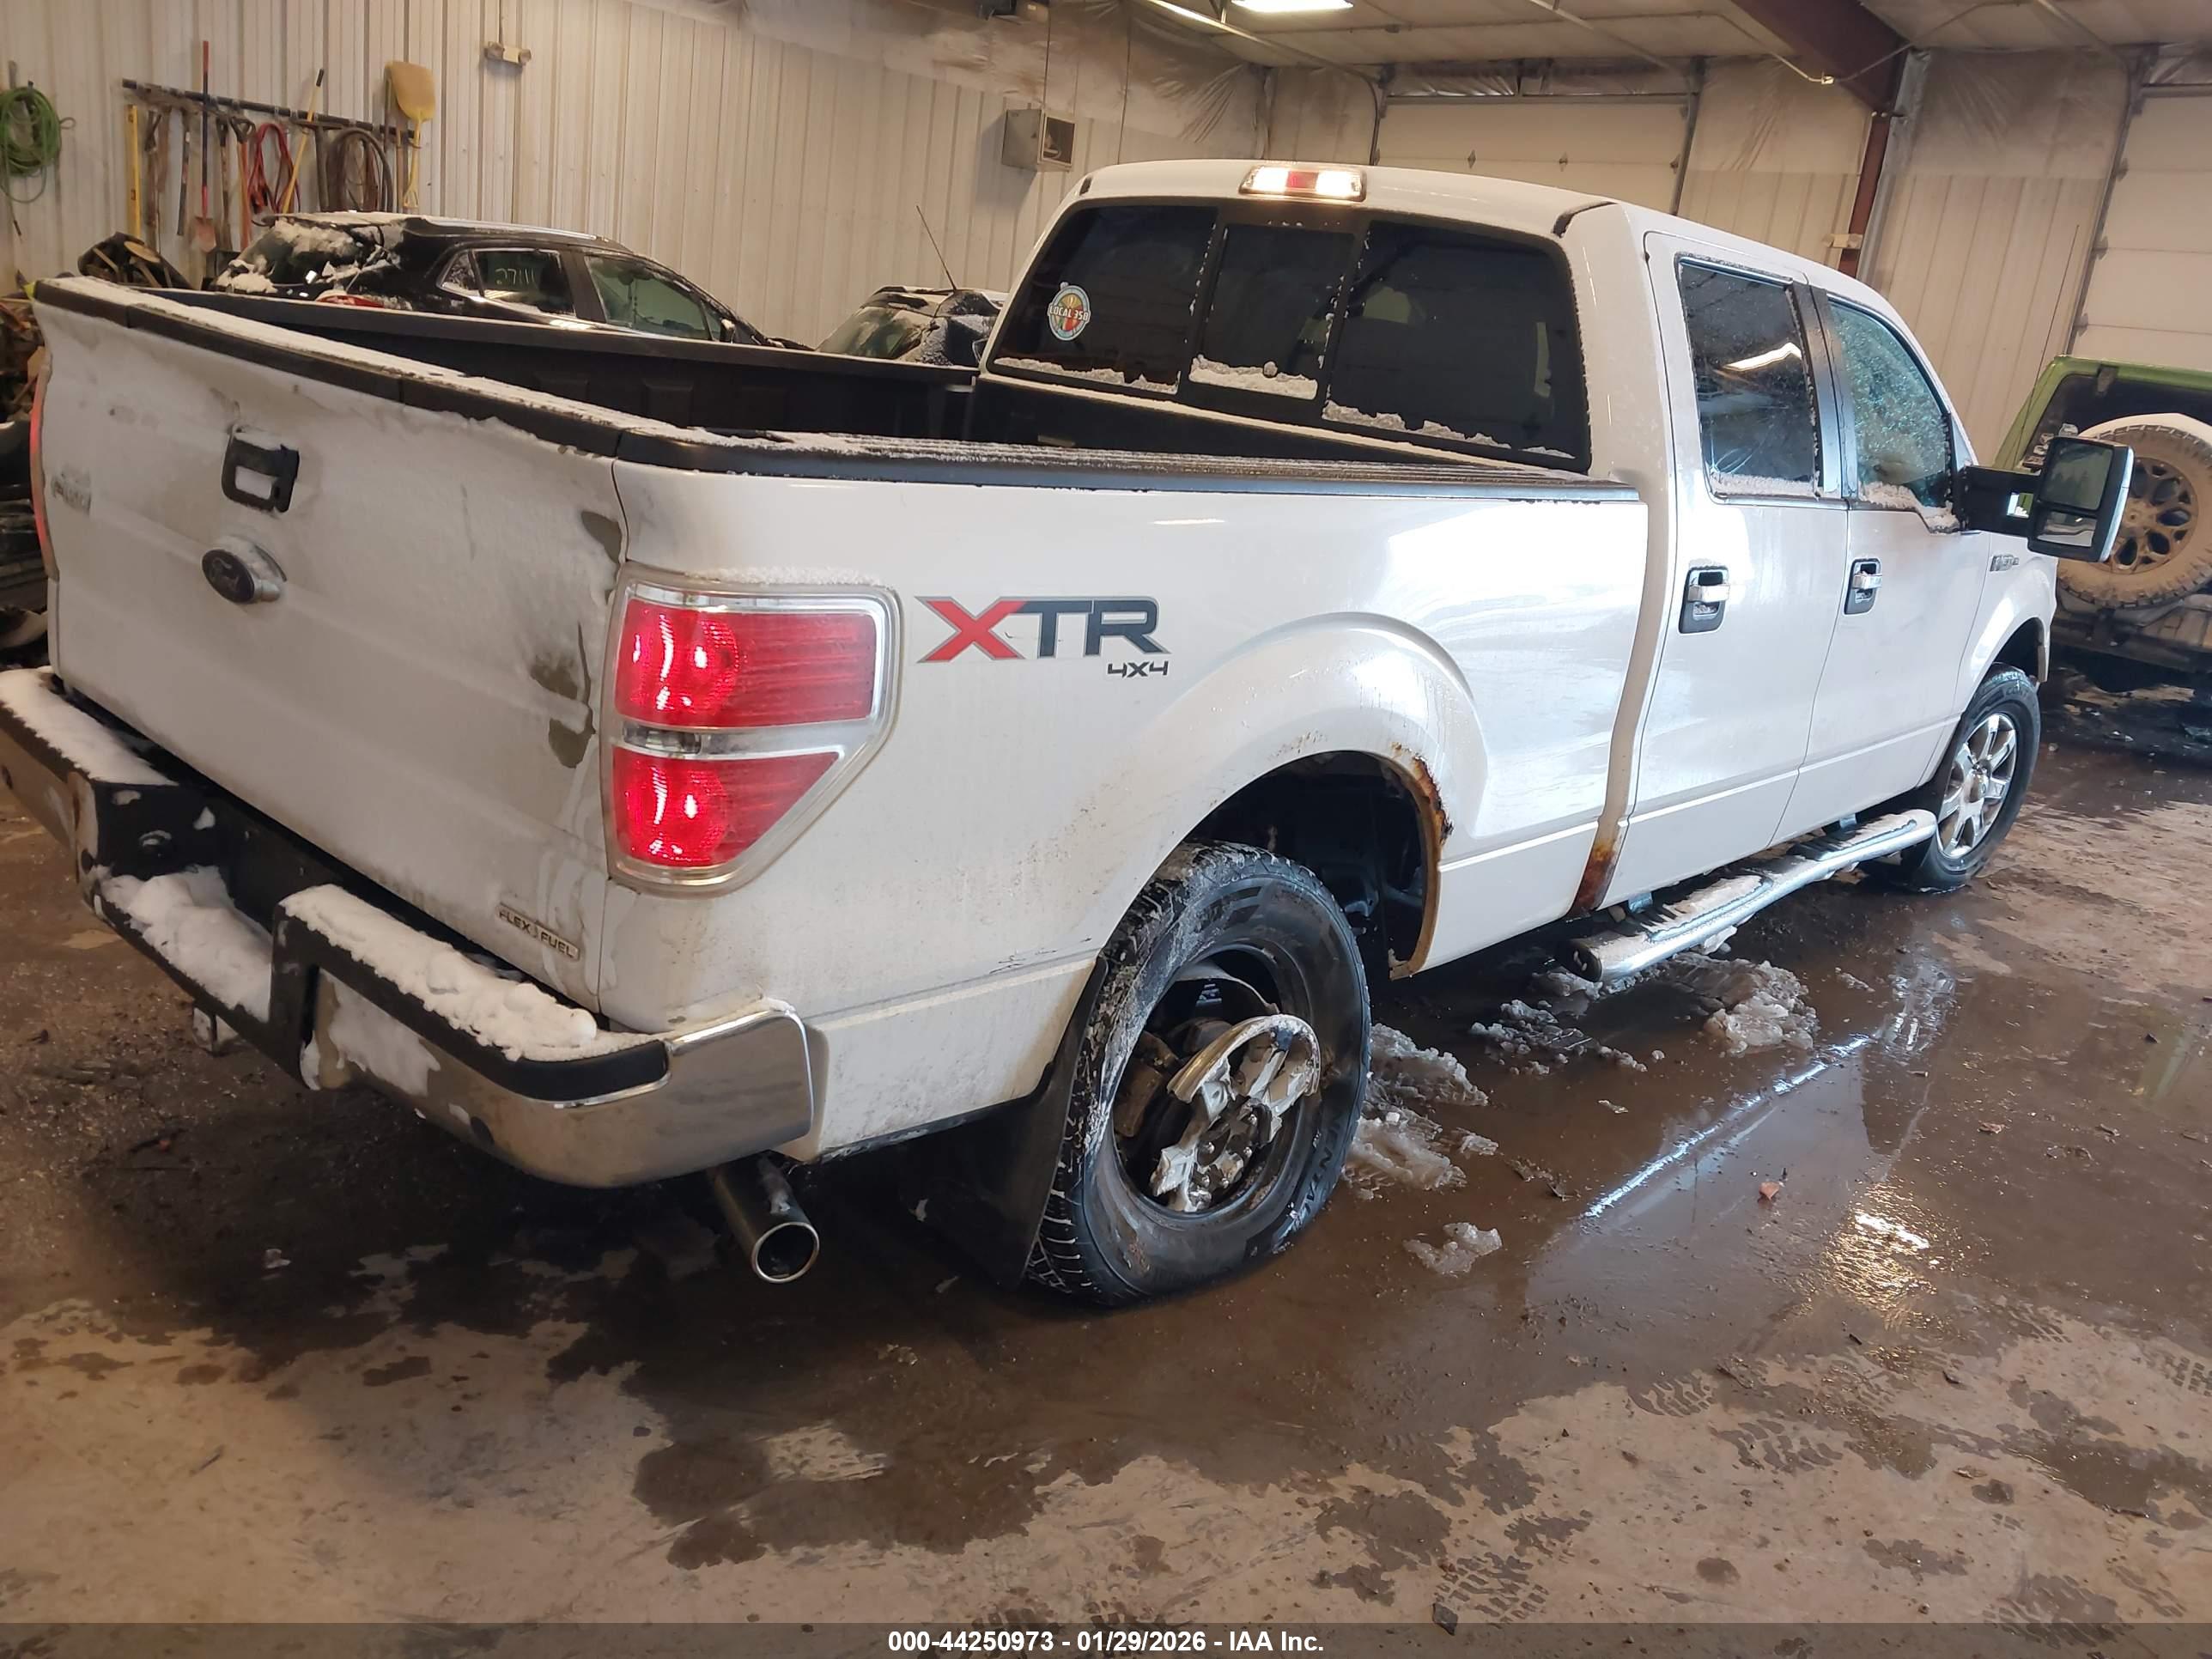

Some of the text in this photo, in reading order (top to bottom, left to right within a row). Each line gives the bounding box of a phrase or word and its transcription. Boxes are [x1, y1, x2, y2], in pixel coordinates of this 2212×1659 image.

[1049, 305, 1072, 318] LOCAL
[914, 595, 1172, 663] XTR
[498, 910, 574, 959] FLEX FUEL
